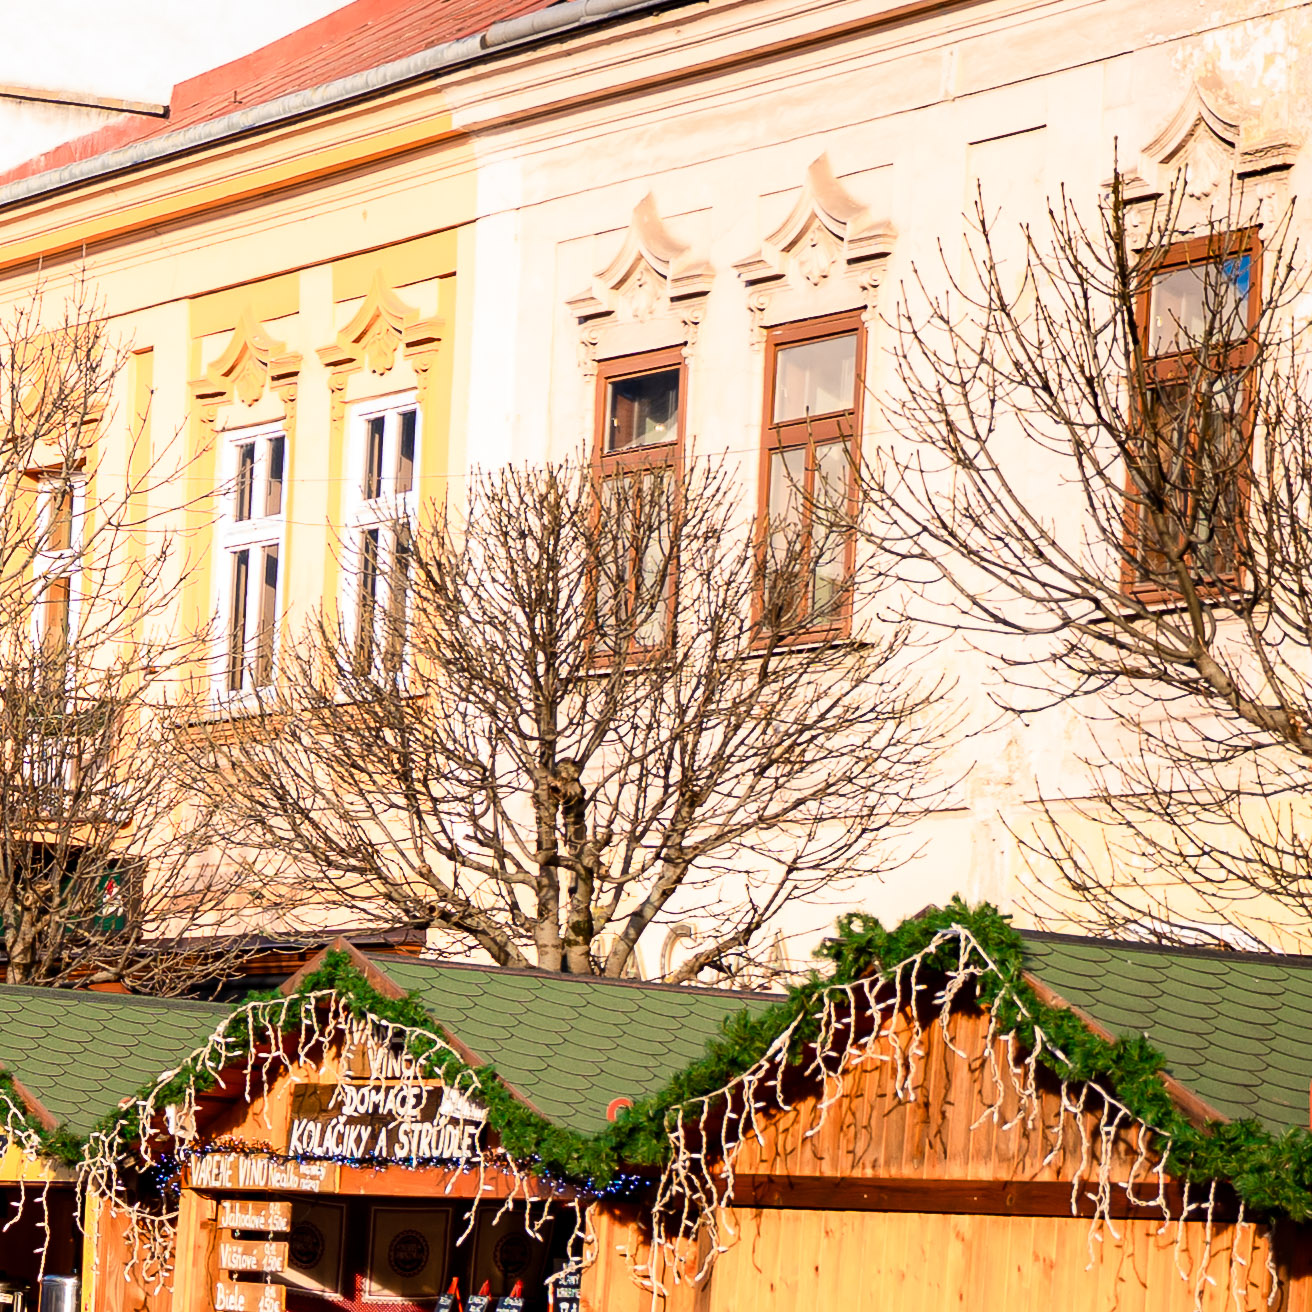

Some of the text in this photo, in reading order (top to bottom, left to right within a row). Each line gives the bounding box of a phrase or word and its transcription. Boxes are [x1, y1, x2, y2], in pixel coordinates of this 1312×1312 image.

[289, 1116, 372, 1159] KOLÁČIKY
[376, 1127, 386, 1157] A
[215, 1282, 245, 1312] Biele
